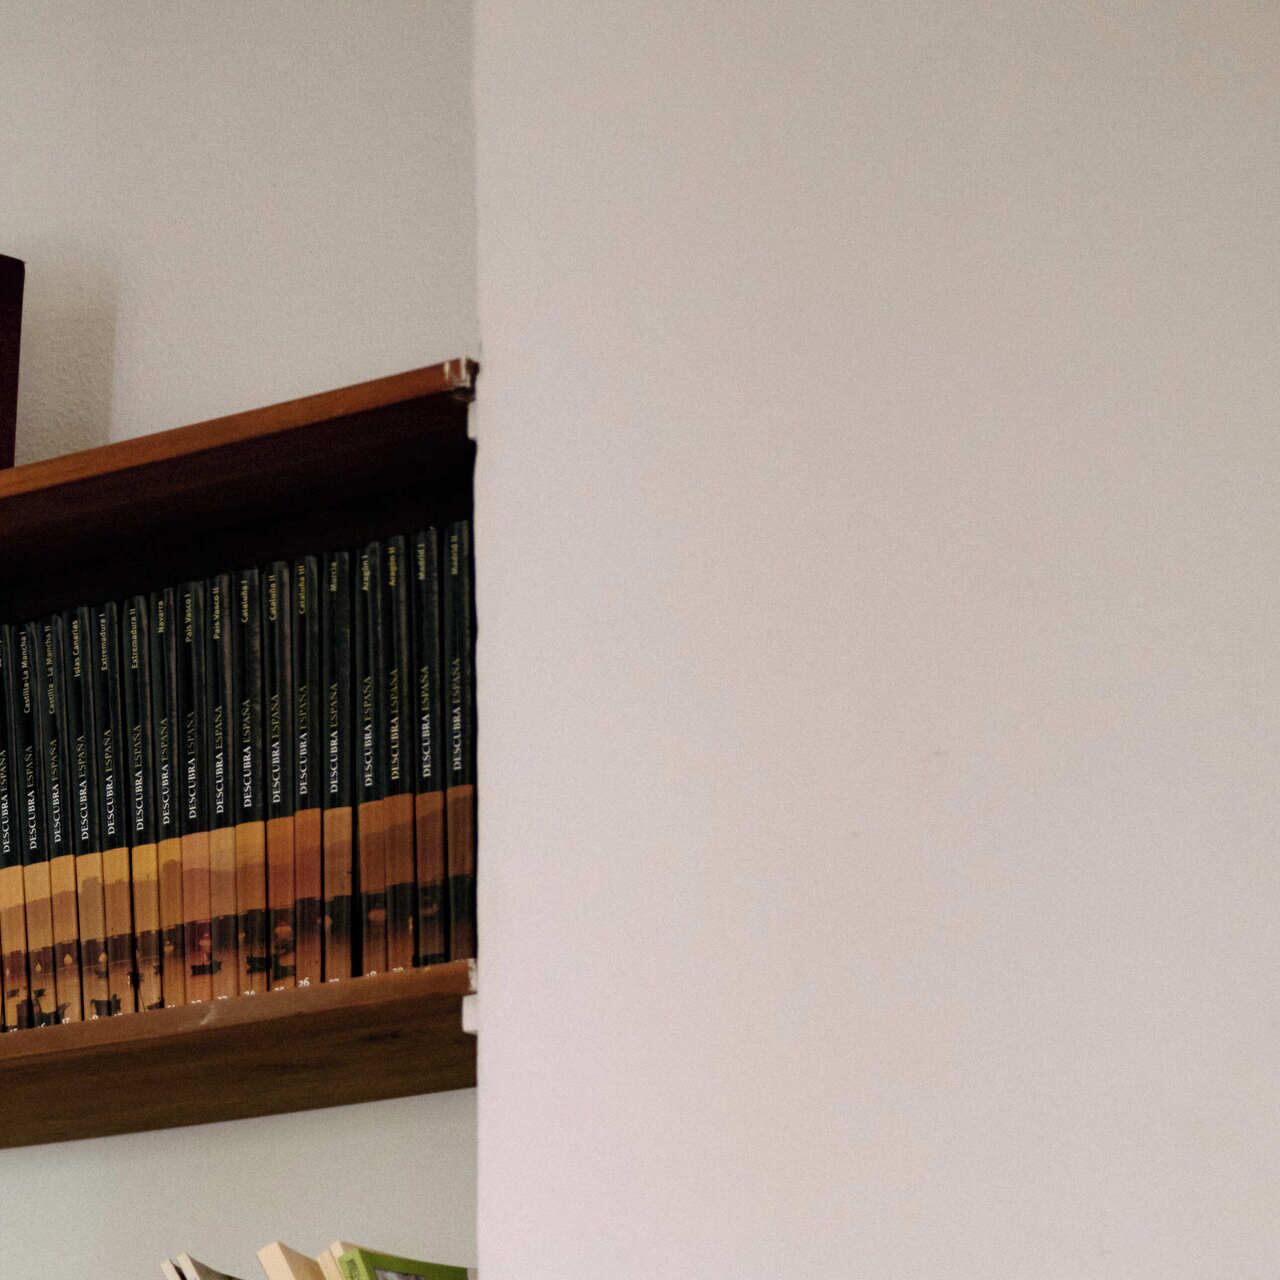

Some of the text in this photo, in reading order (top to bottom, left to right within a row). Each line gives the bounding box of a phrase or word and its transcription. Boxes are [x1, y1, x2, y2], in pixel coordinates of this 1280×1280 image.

[183, 598, 193, 623] Vasco
[128, 617, 139, 669] Extremadura
[70, 620, 89, 840] DESCUBRA ESPAÑA Islas Canarias
[328, 683, 338, 727] ESPAÑA
[131, 725, 142, 767] ESPAÑA
[329, 731, 339, 793] DESCUBRA
[134, 771, 145, 831] DESCUBRA
[187, 758, 197, 819] DESCUBRA
[1, 795, 11, 853] DESCUBRA
